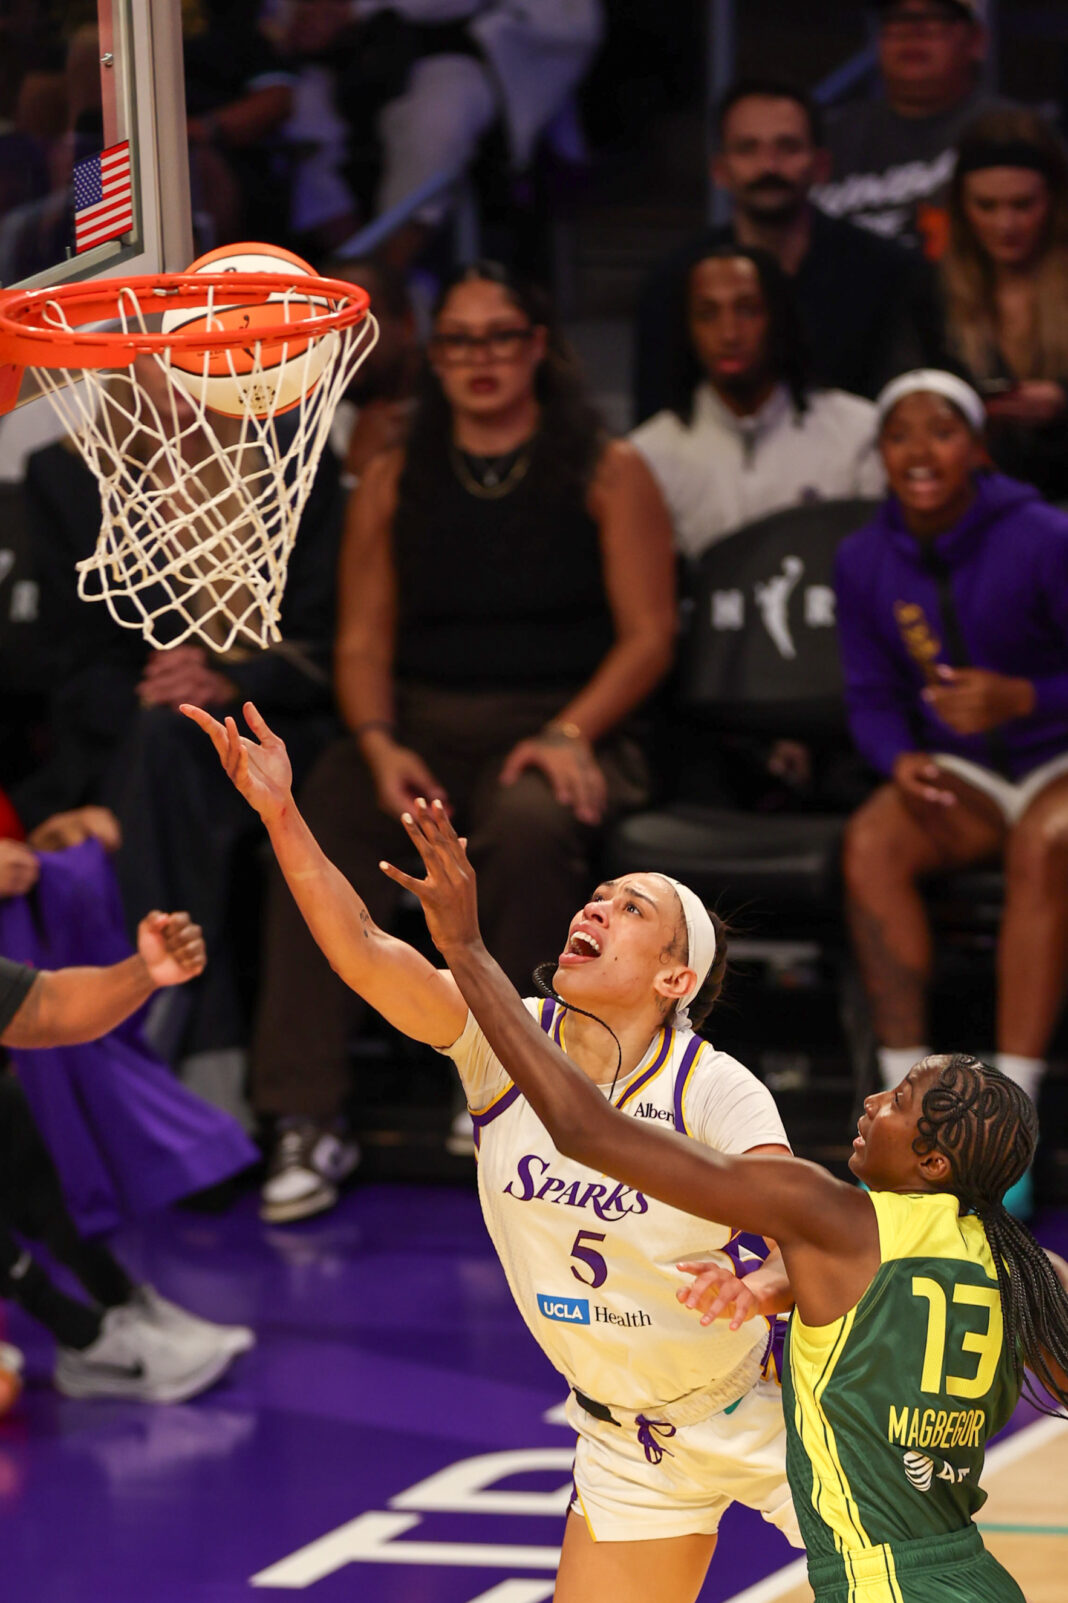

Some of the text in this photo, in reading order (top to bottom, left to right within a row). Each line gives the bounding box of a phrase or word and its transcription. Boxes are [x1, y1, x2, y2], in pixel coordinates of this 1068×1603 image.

[570, 1230, 608, 1289] 5
[543, 1301, 653, 1328] UCLA Health
[911, 1276, 1004, 1400] 13
[888, 1404, 985, 1449] MAGBEGOR
